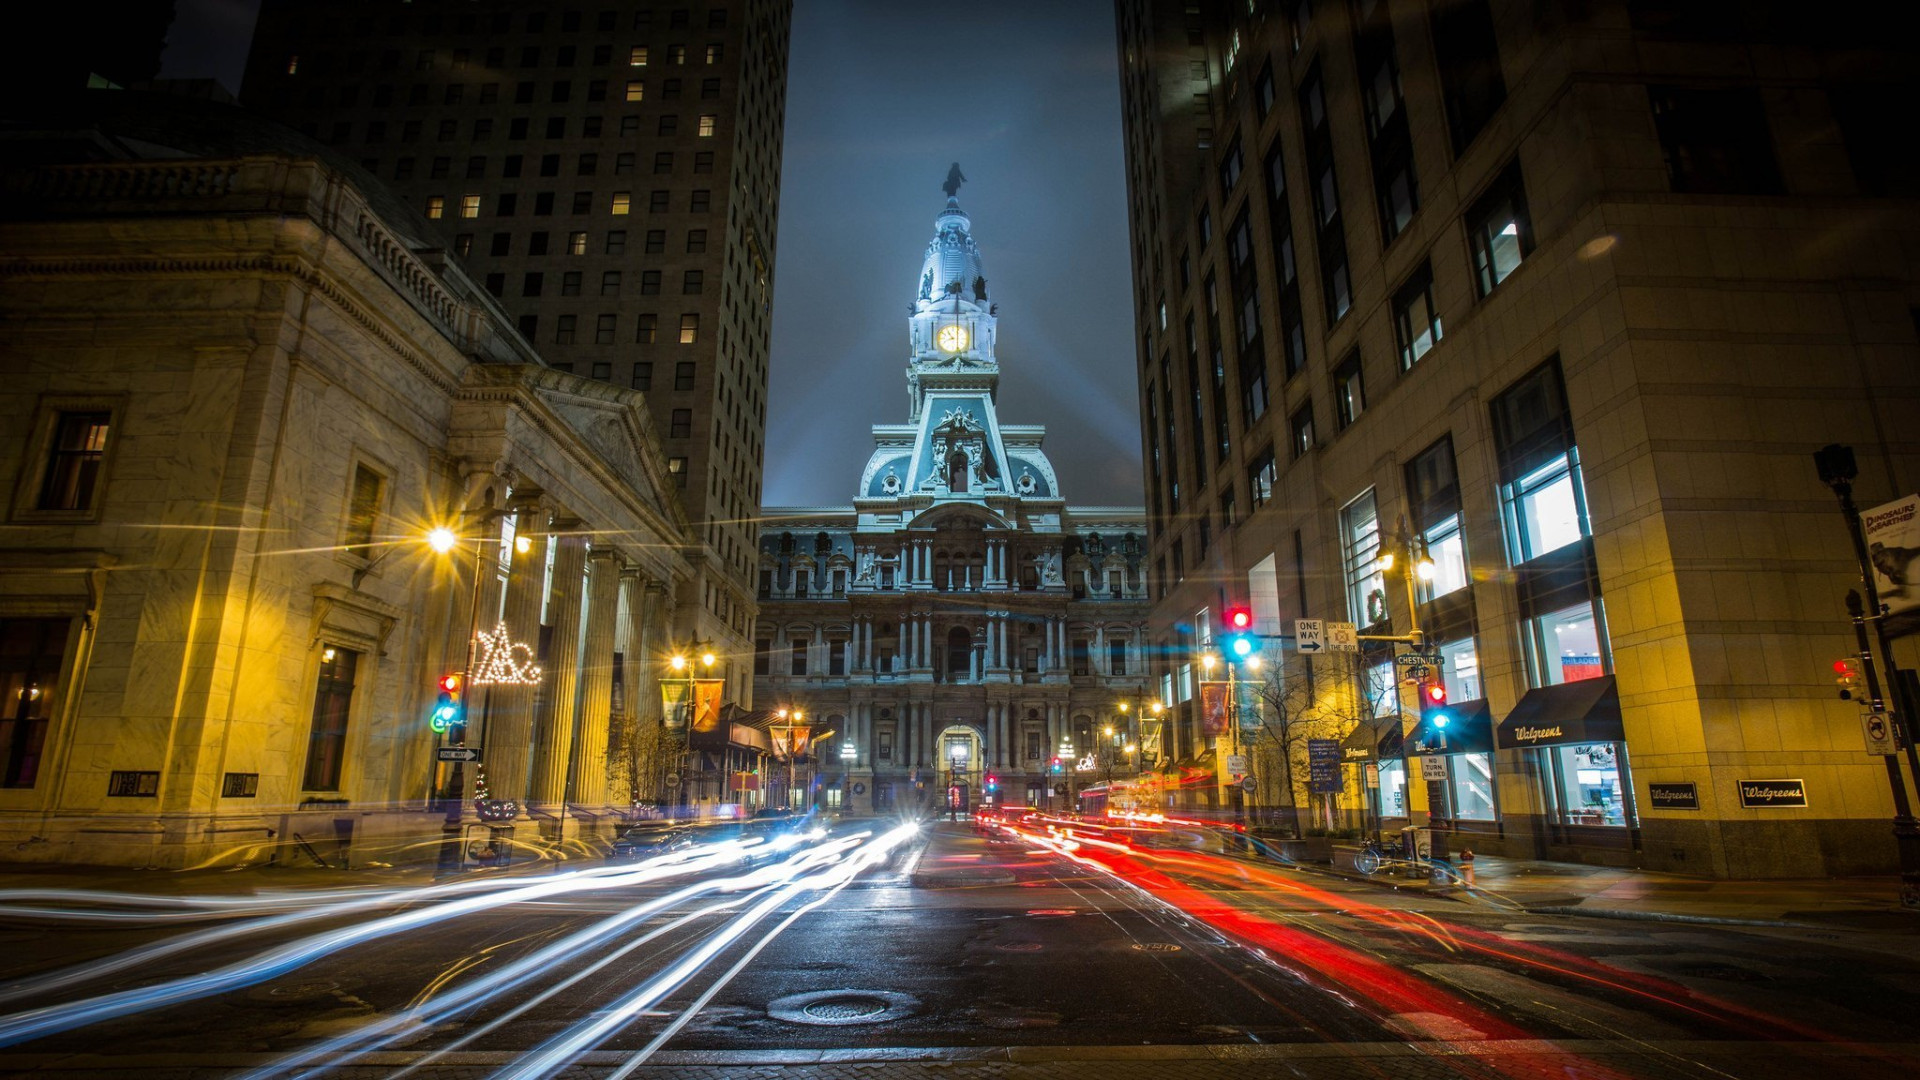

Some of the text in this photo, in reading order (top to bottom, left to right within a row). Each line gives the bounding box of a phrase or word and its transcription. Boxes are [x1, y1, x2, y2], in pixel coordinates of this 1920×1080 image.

[1866, 503, 1916, 527] DINOSAURS
[1300, 622, 1318, 630] ONE
[1300, 631, 1319, 639] WAY
[1398, 656, 1435, 664] CHESTNUT
[1515, 725, 1562, 743] Walgreens
[1652, 789, 1694, 802] Walgreens
[1743, 786, 1803, 801] Walgreens
